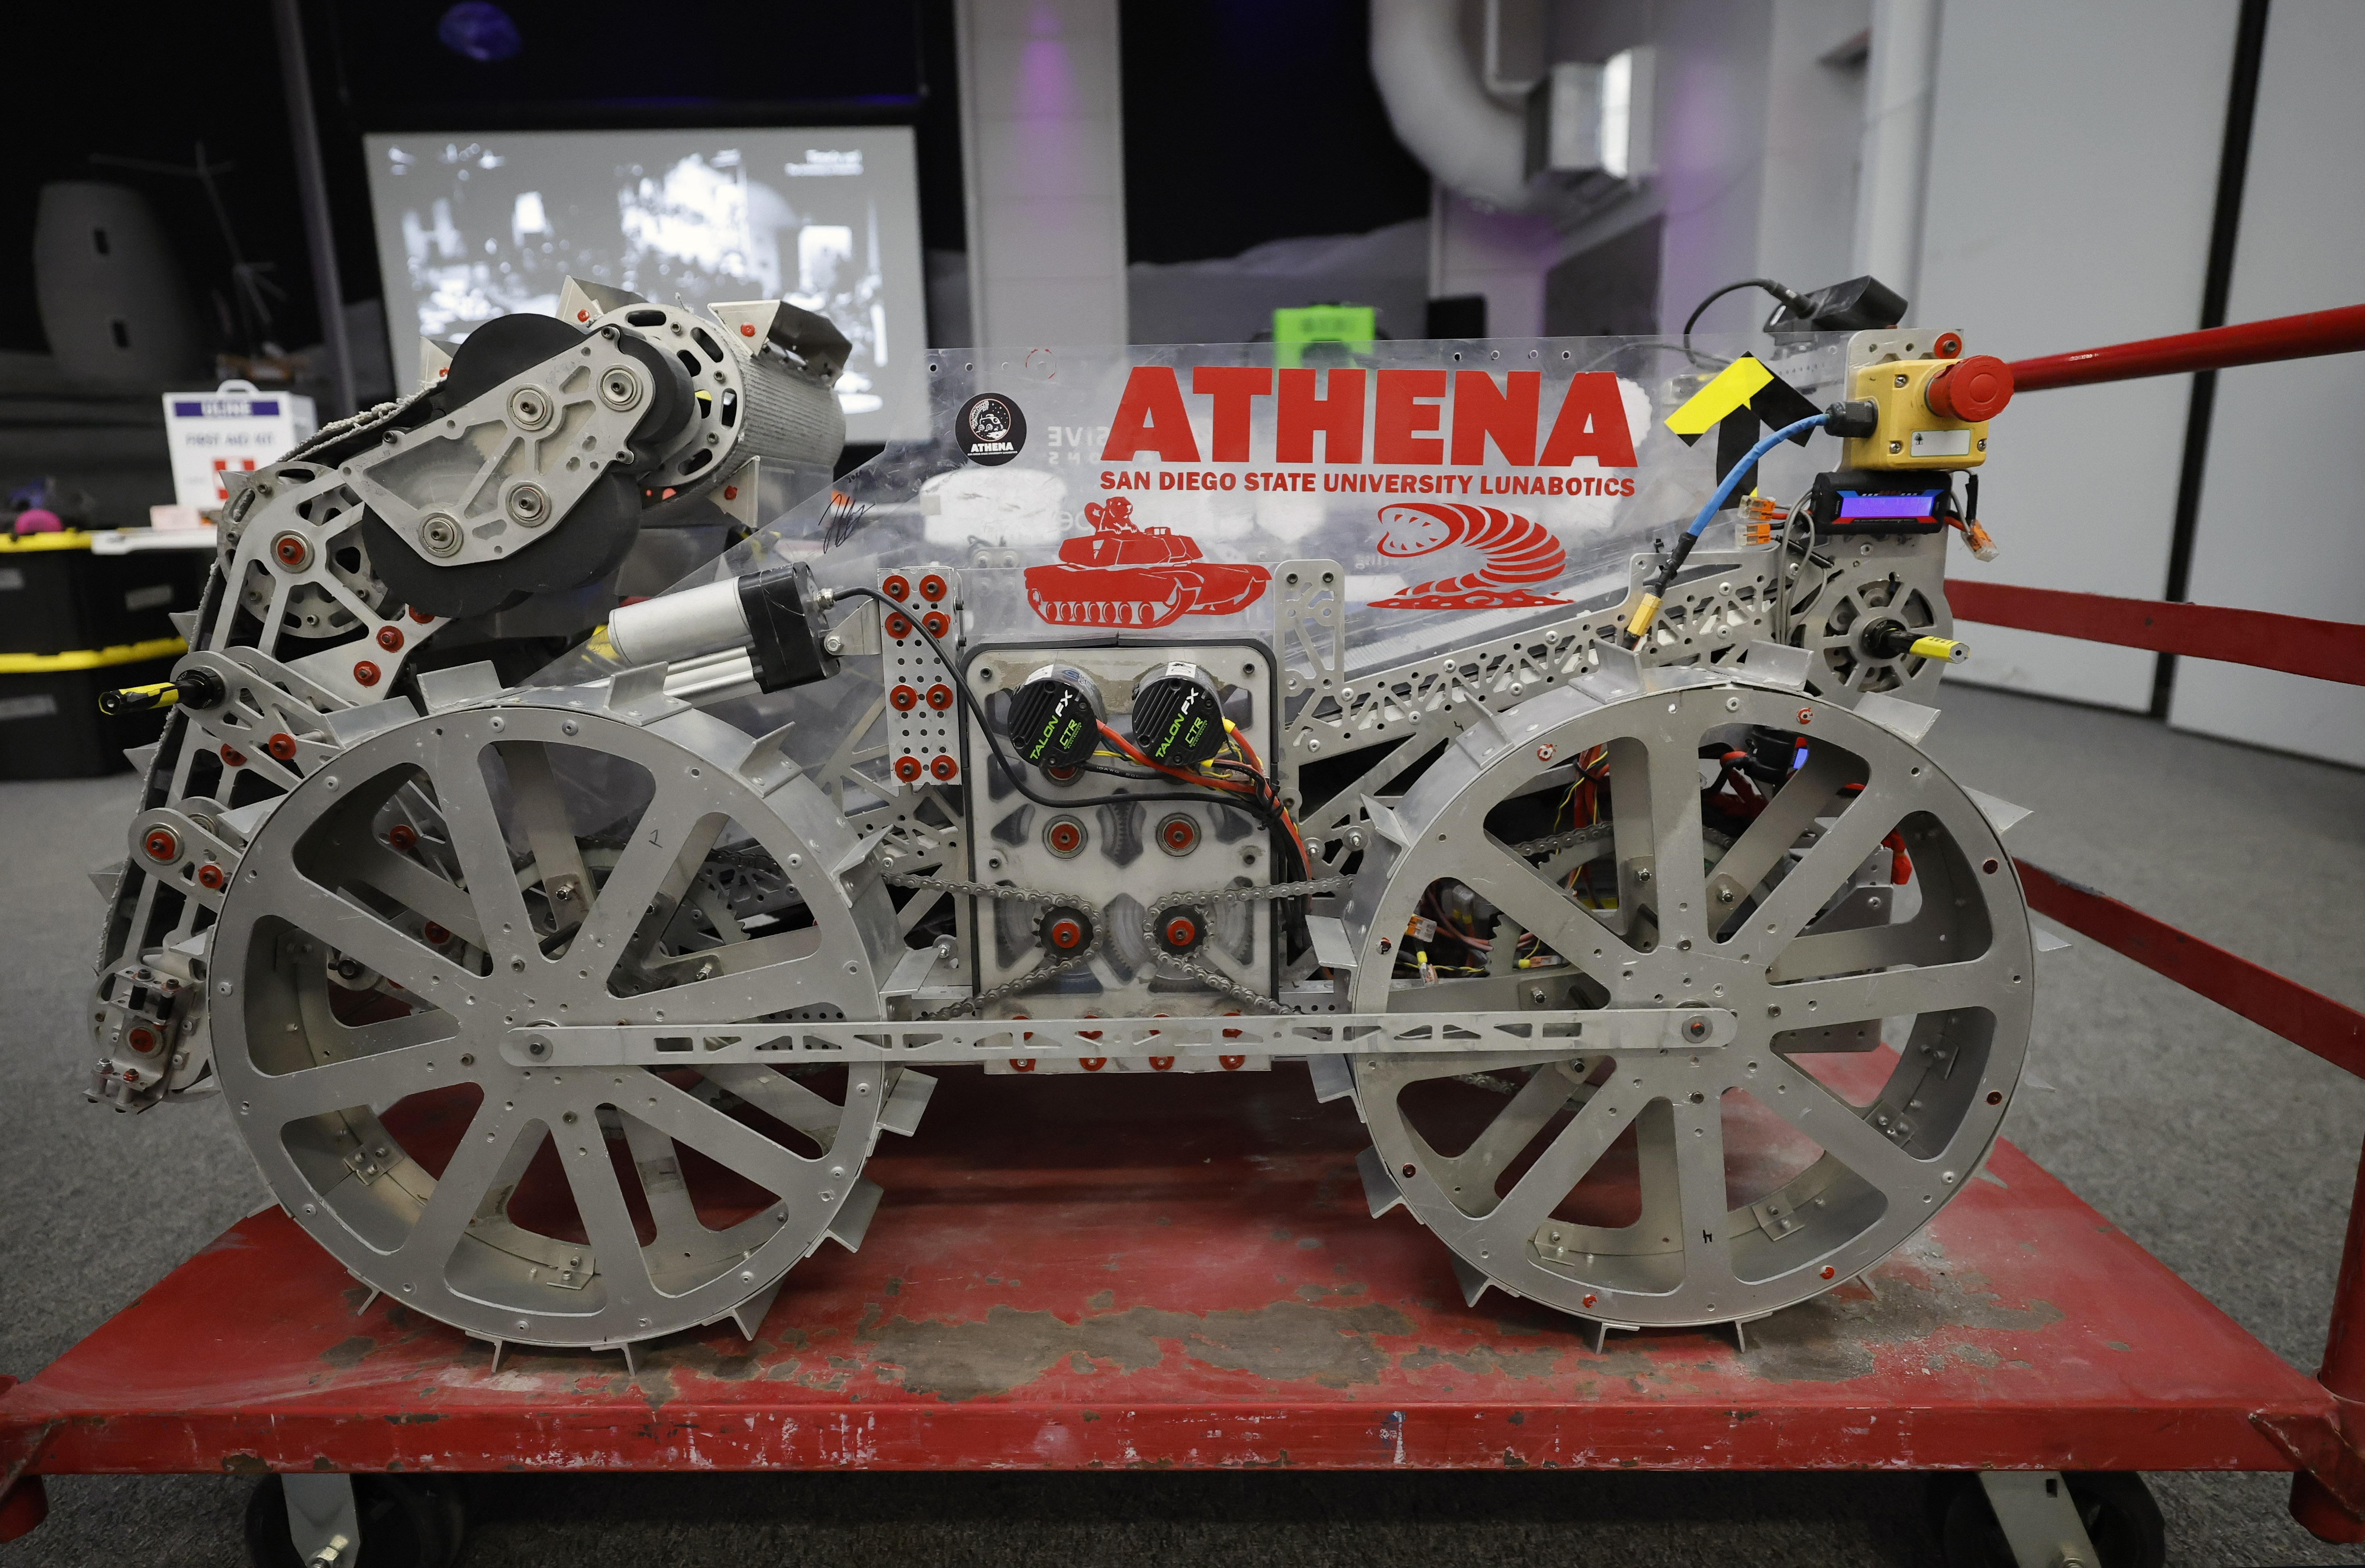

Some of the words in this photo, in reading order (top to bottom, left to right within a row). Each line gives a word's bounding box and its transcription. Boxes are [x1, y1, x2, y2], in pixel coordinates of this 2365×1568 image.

[1101, 366, 1638, 467] ATHENA
[971, 442, 1014, 453] ATHENA
[1100, 471, 1150, 490] SAN
[1160, 472, 1236, 491] DIEGO
[1244, 472, 1316, 492] STATE
[1324, 473, 1473, 494] UNIVERSITY
[1480, 476, 1636, 497] LUNABOTICS
[1030, 714, 1059, 760] TALON
[1055, 689, 1073, 717] FX
[1059, 719, 1078, 746] CTR
[1155, 713, 1185, 758] TALON
[1181, 687, 1199, 715] FX
[1185, 717, 1204, 745] CTR
